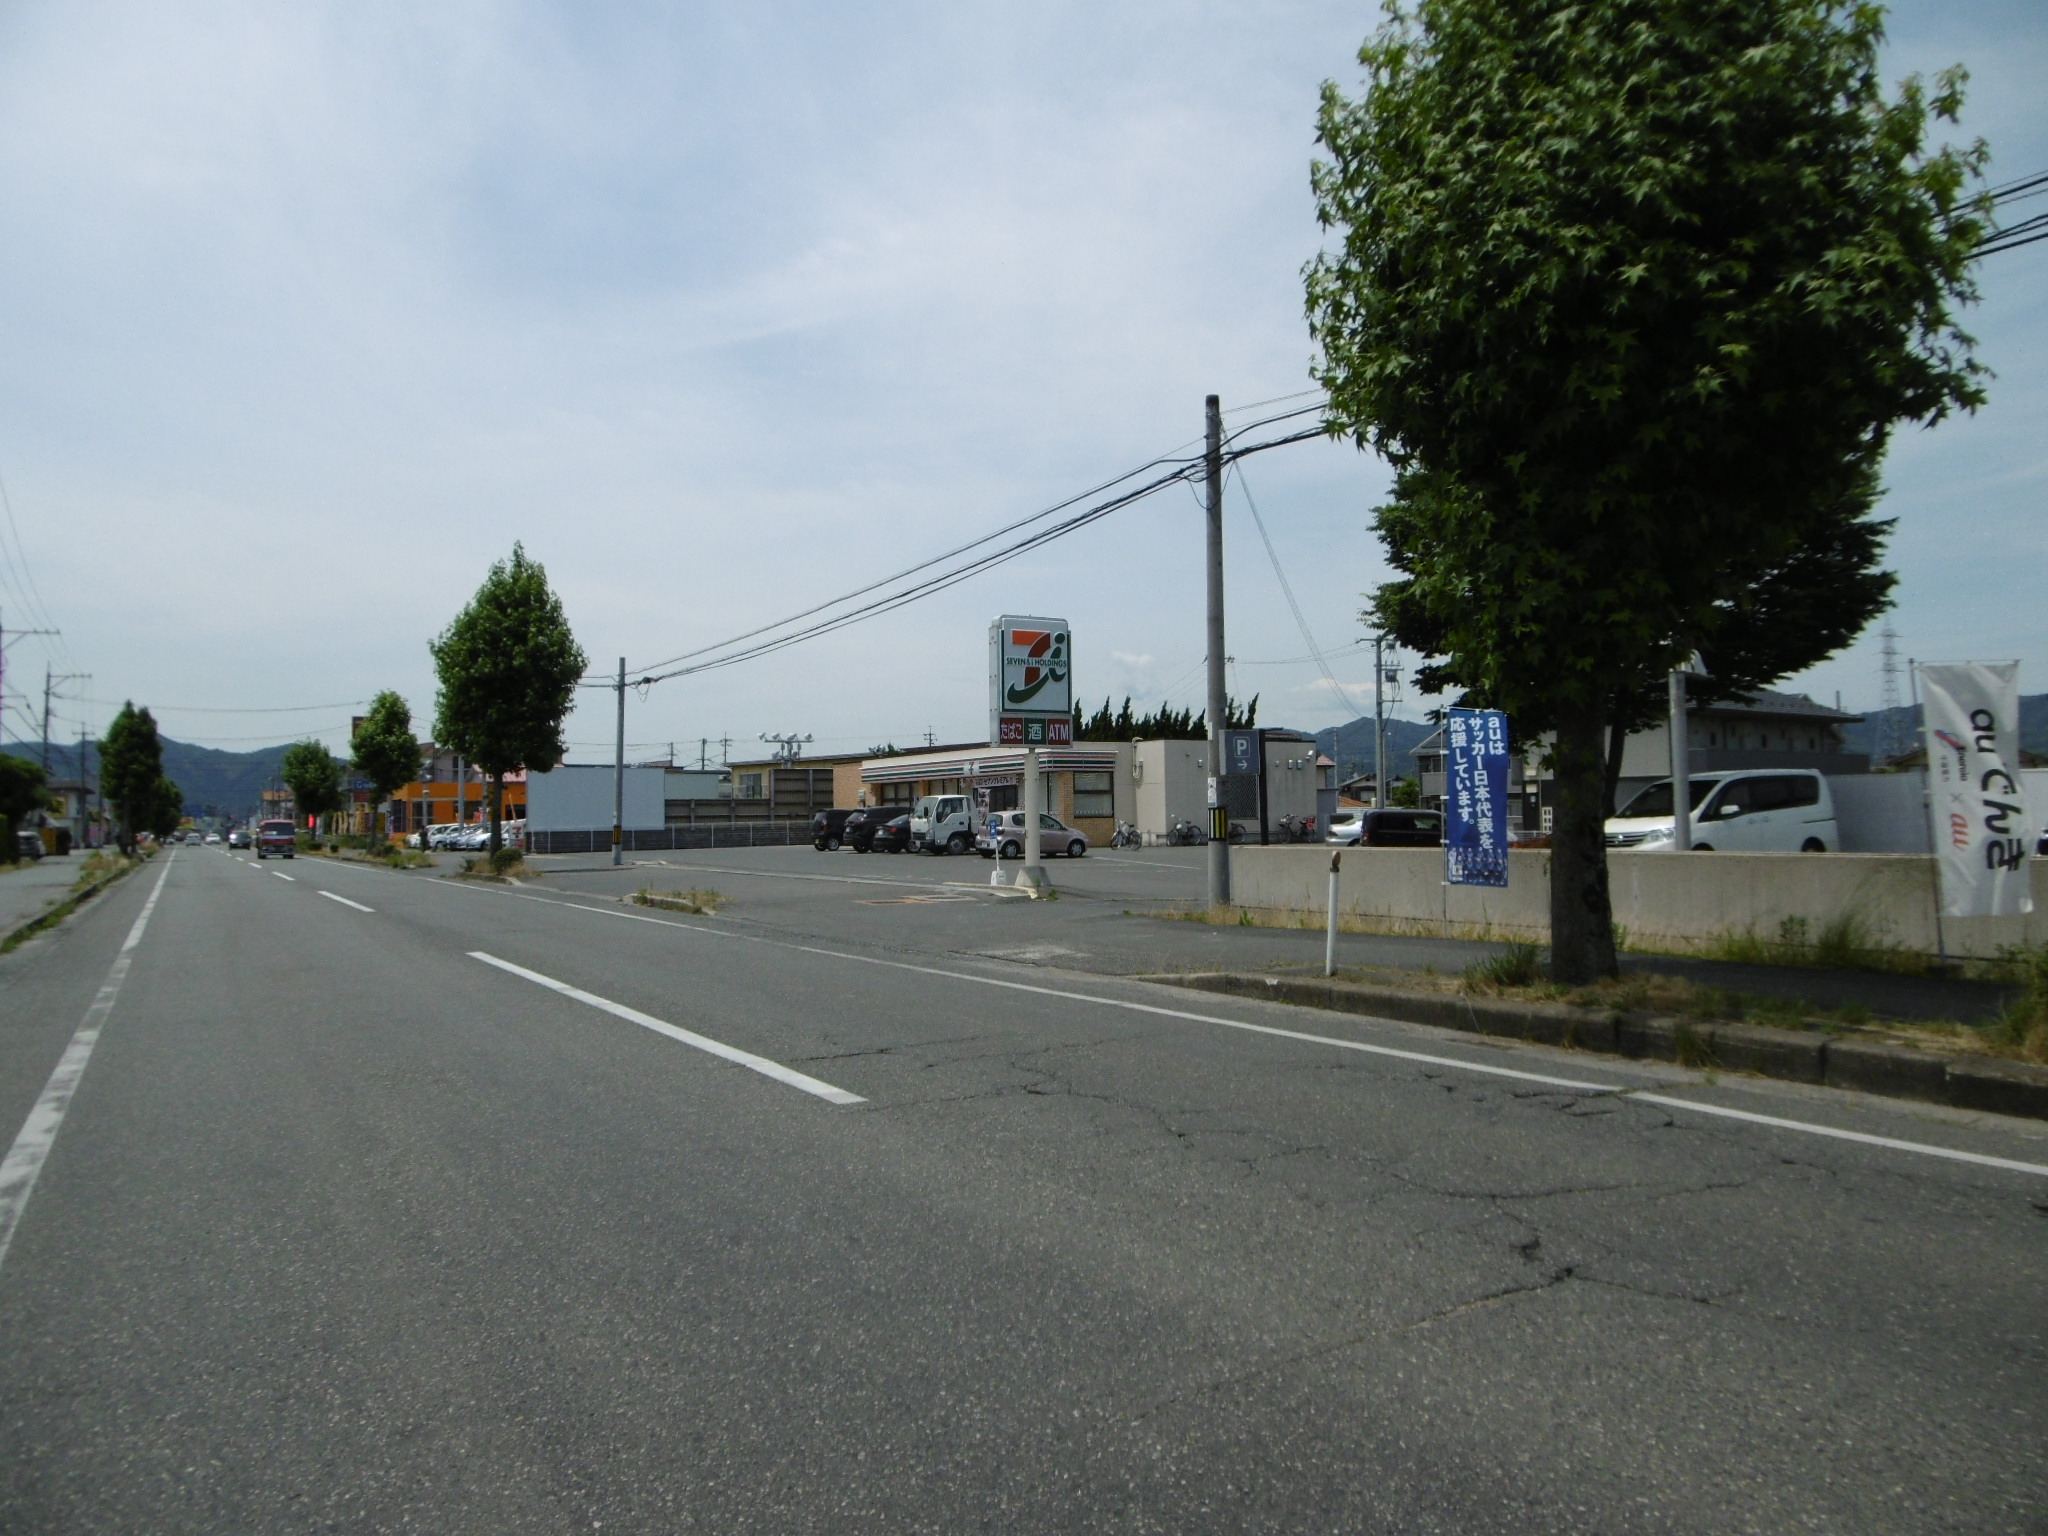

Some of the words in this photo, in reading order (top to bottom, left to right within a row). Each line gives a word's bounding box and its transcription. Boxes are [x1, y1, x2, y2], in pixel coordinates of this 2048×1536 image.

[1034, 658, 1066, 668] HOLDINGS
[1000, 723, 1022, 740] たばこ
[1028, 723, 1043, 740] 酒
[1048, 723, 1069, 740] ATM
[1487, 716, 1506, 755] auは
[1236, 739, 1248, 755] P
[1449, 717, 1475, 825] 応援しています。
[1468, 717, 1494, 849] サッカー日本代表を
[1951, 813, 1970, 852] au
